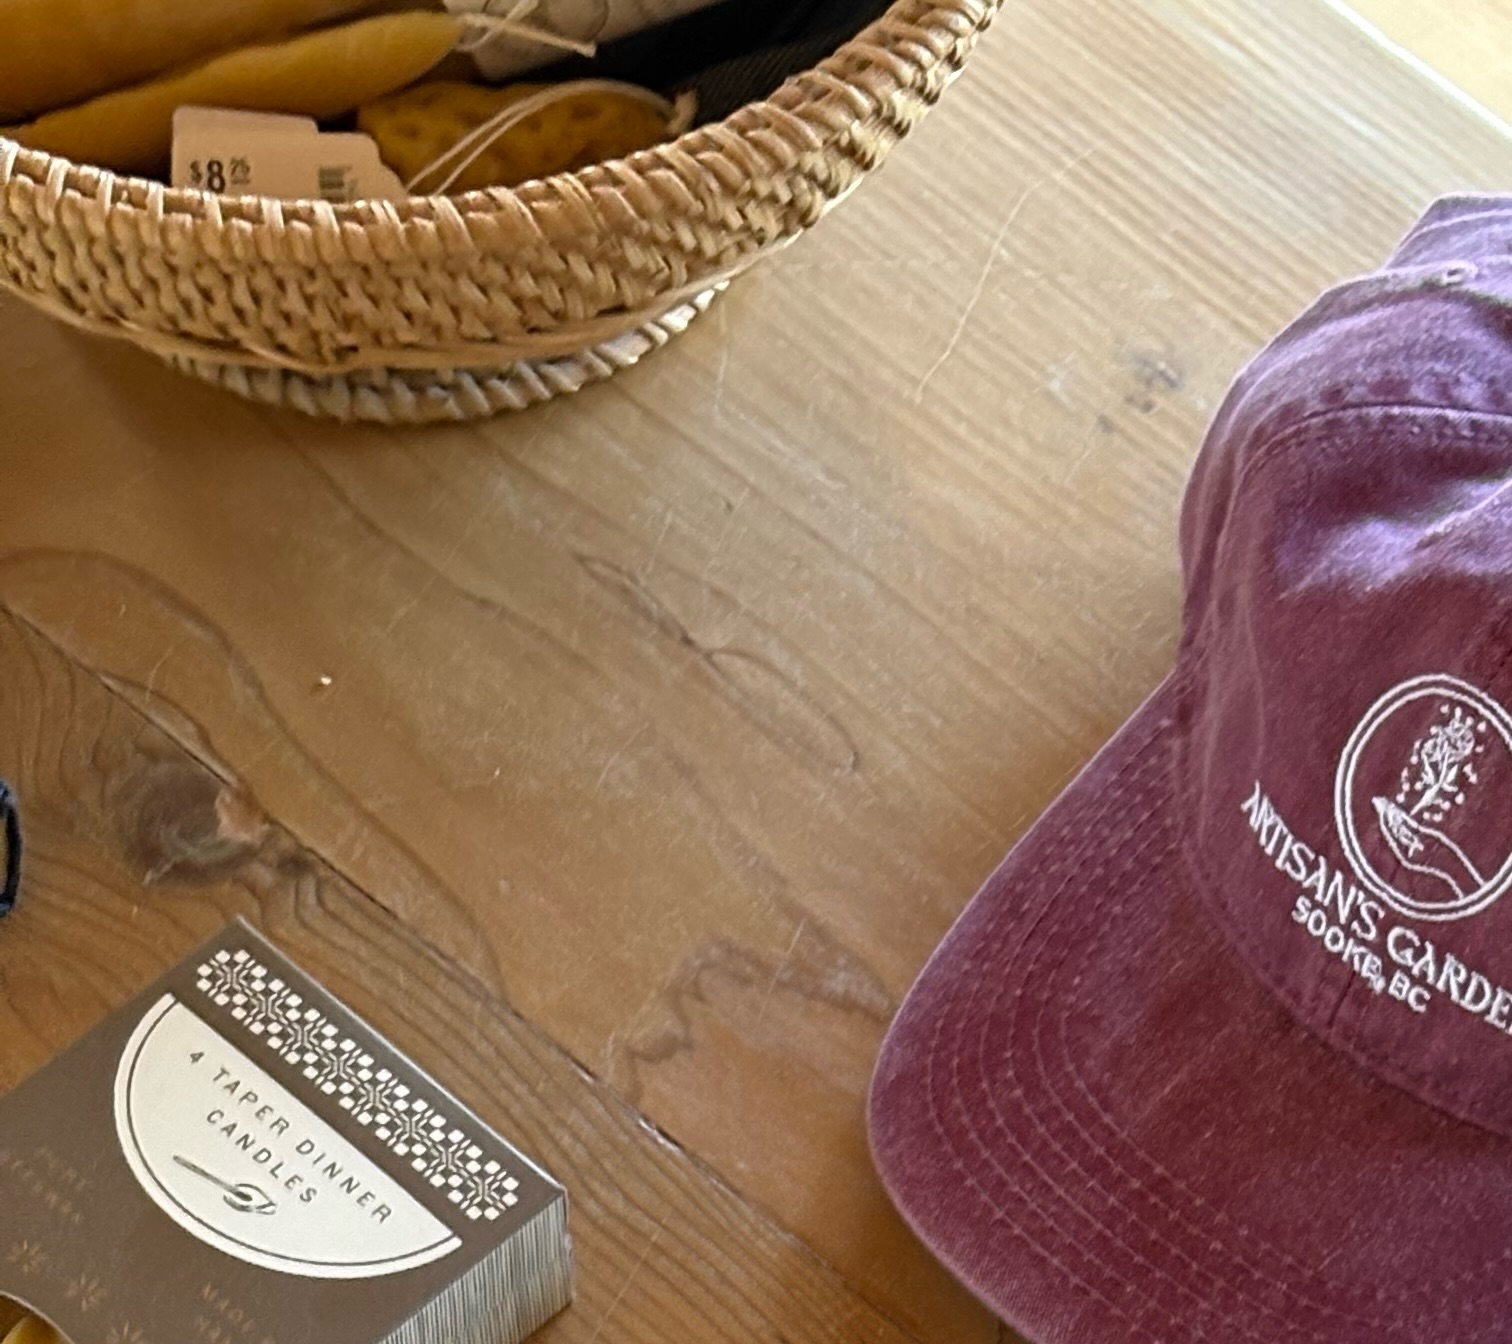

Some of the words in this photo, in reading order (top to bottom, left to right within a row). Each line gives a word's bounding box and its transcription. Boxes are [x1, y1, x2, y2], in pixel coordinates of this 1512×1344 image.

[1241, 779, 1386, 941] ARTISAN'S
[1388, 971, 1432, 1013] BC
[189, 1051, 205, 1065] 4
[212, 1066, 291, 1138] TAPER
[295, 1138, 393, 1225] DINNER
[206, 1109, 318, 1204] CANDLES
